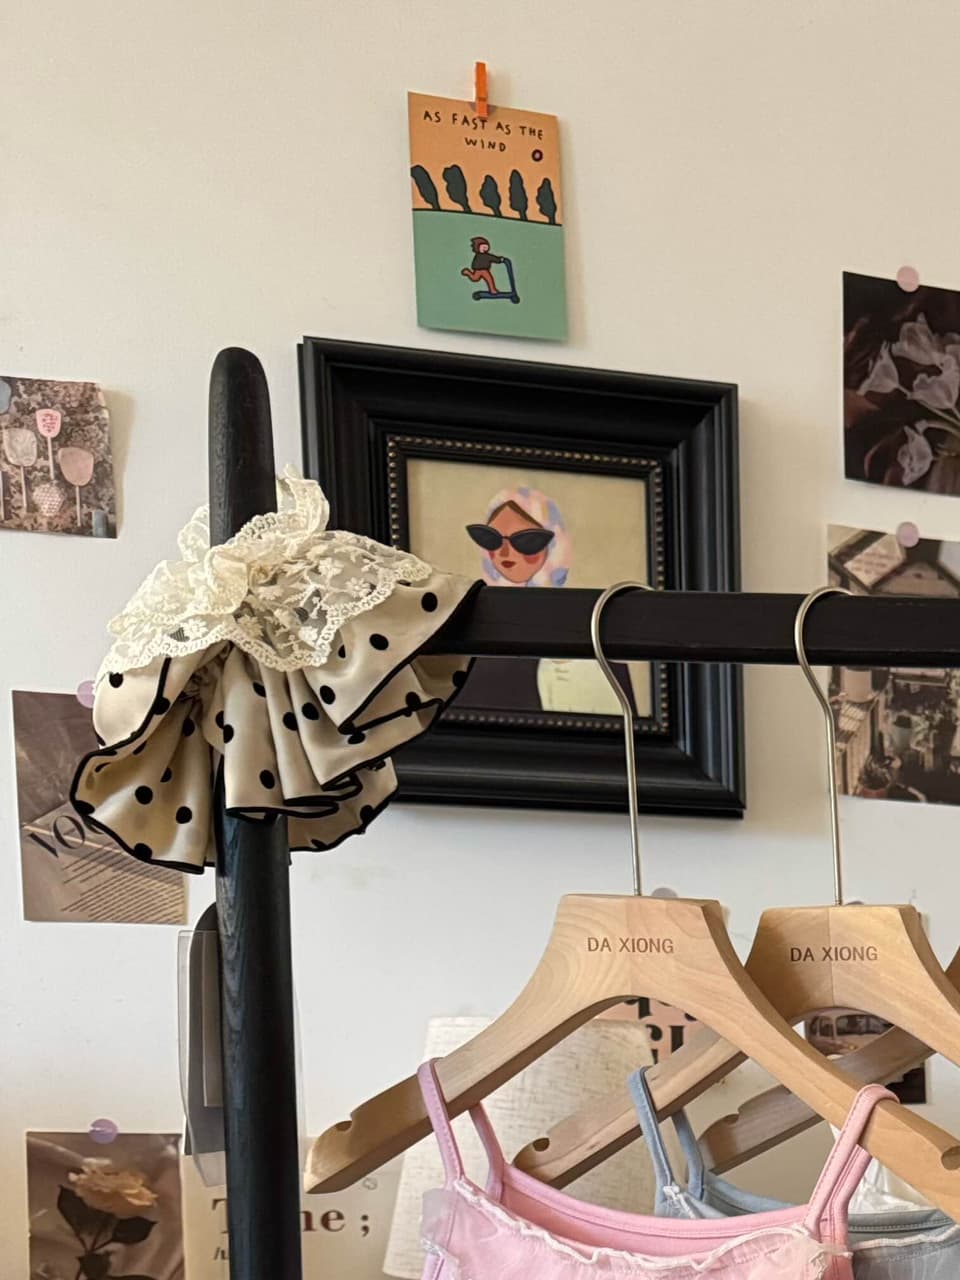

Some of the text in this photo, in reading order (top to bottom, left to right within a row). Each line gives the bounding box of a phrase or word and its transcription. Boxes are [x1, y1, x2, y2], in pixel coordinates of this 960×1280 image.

[423, 110, 544, 141] AS FAST AS THE
[464, 136, 506, 152] WIND
[587, 937, 674, 953] DA XIONG
[790, 946, 878, 962] DA XIONG
